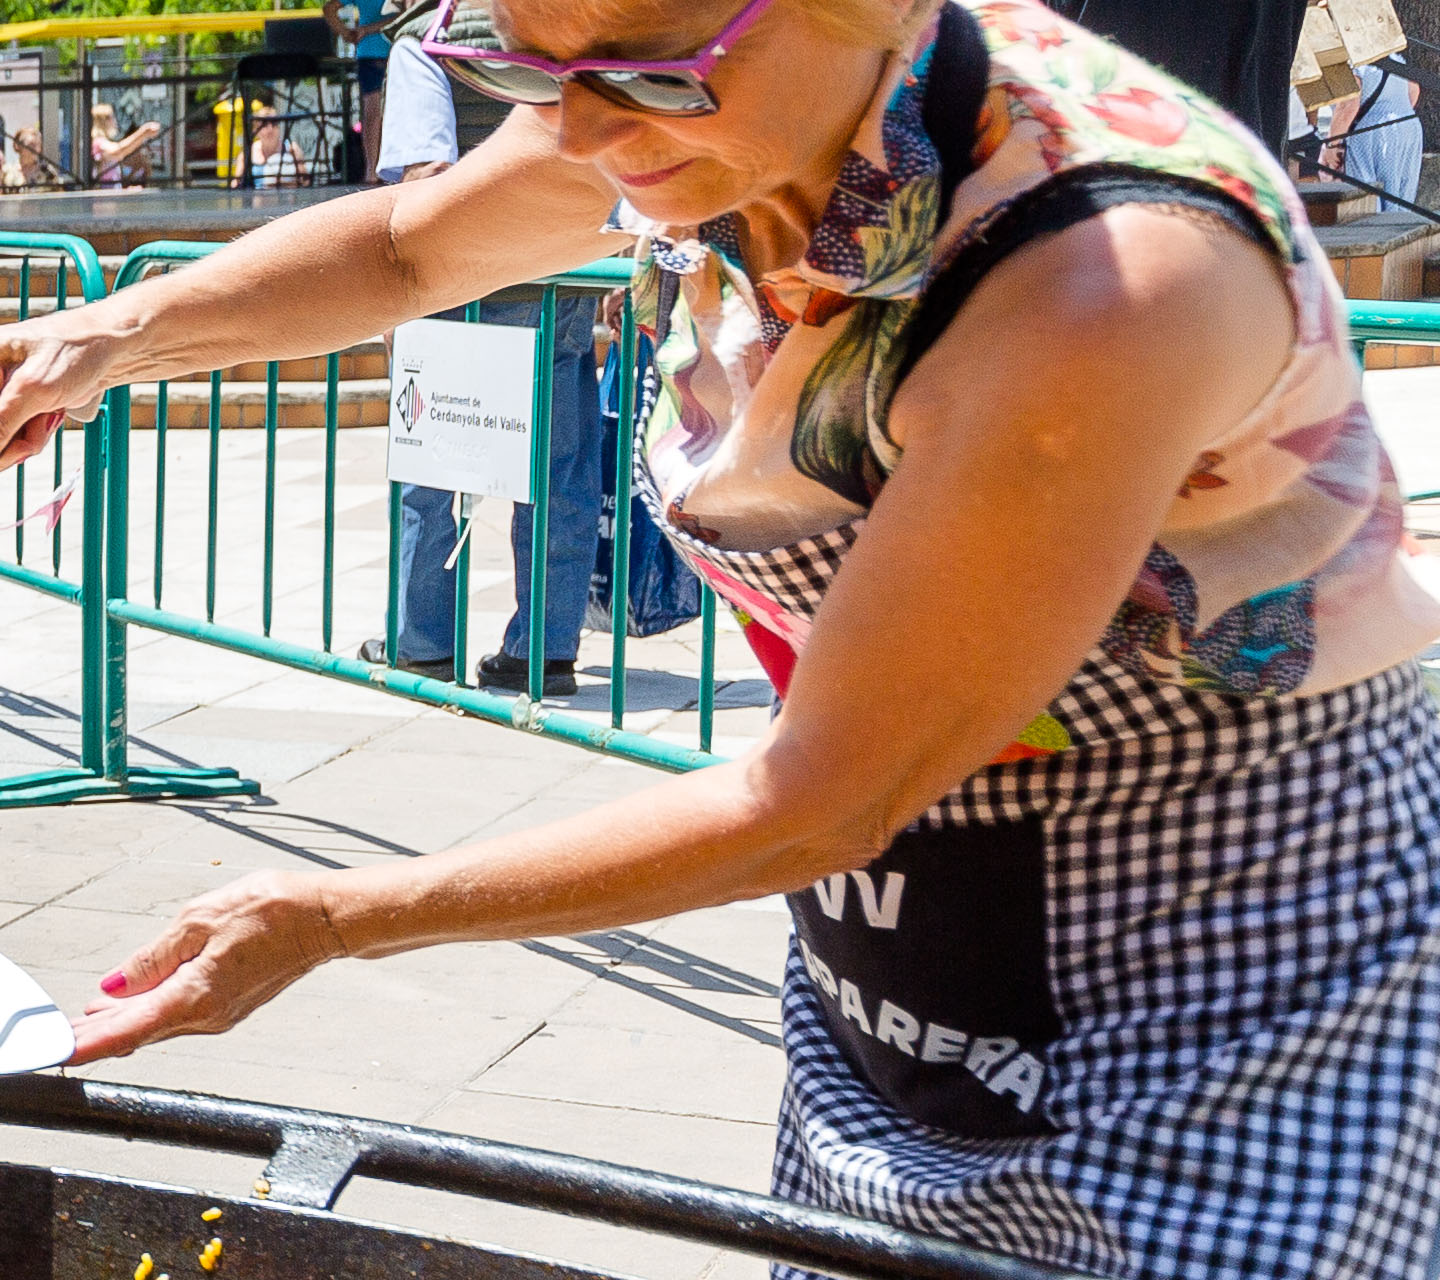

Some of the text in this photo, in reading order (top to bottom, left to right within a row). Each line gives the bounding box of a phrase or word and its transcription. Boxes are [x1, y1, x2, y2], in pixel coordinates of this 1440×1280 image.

[431, 392, 481, 409] Ajuntament de
[430, 407, 481, 428] Cerdanyola
[483, 416, 498, 429] del
